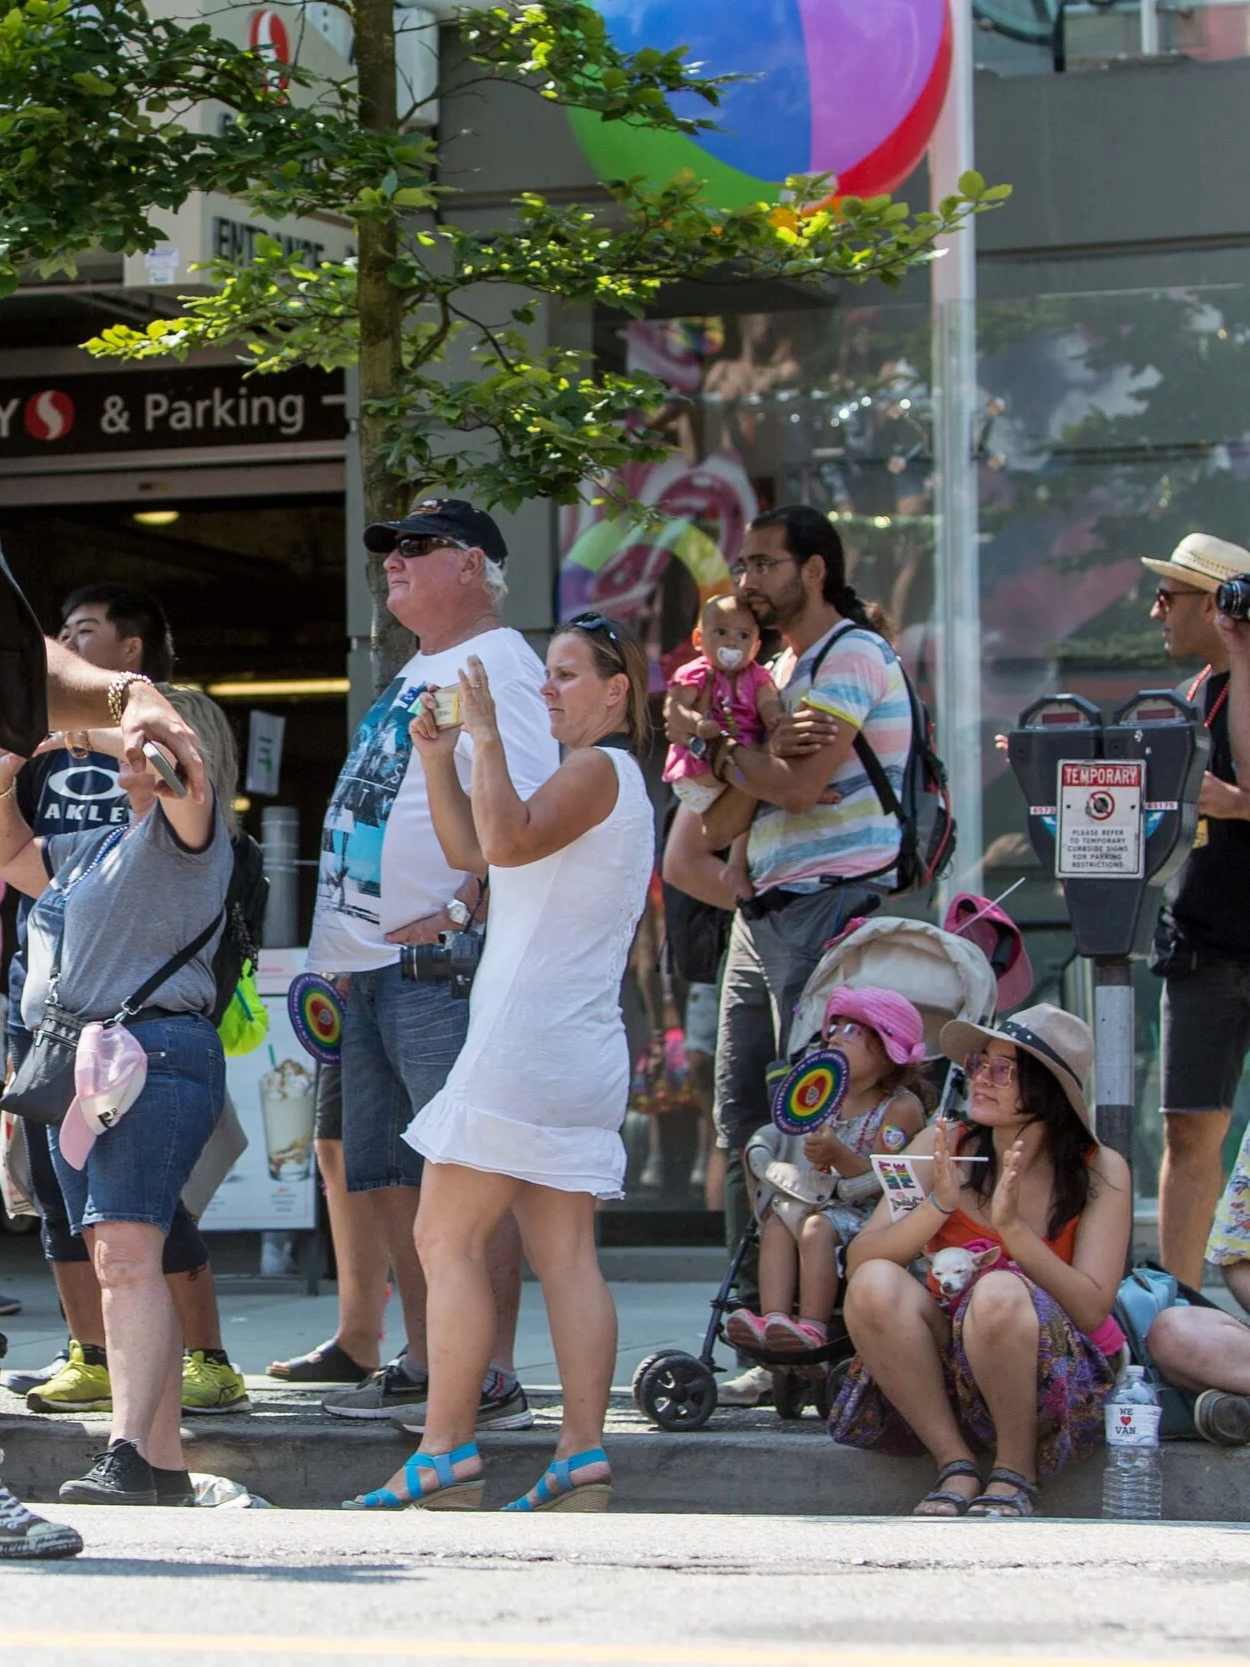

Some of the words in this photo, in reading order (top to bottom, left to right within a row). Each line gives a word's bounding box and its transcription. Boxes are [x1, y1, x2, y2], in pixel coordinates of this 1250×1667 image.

[101, 395, 130, 434] &
[145, 388, 305, 434] Parking
[1064, 767, 1138, 785] TEMPORARY
[44, 802, 125, 823] AKLE
[1090, 853, 1122, 861] PARKING
[1072, 861, 1123, 869] RESTRICTIONS
[1119, 1407, 1134, 1416] WE
[1115, 1426, 1136, 1435] VAN
